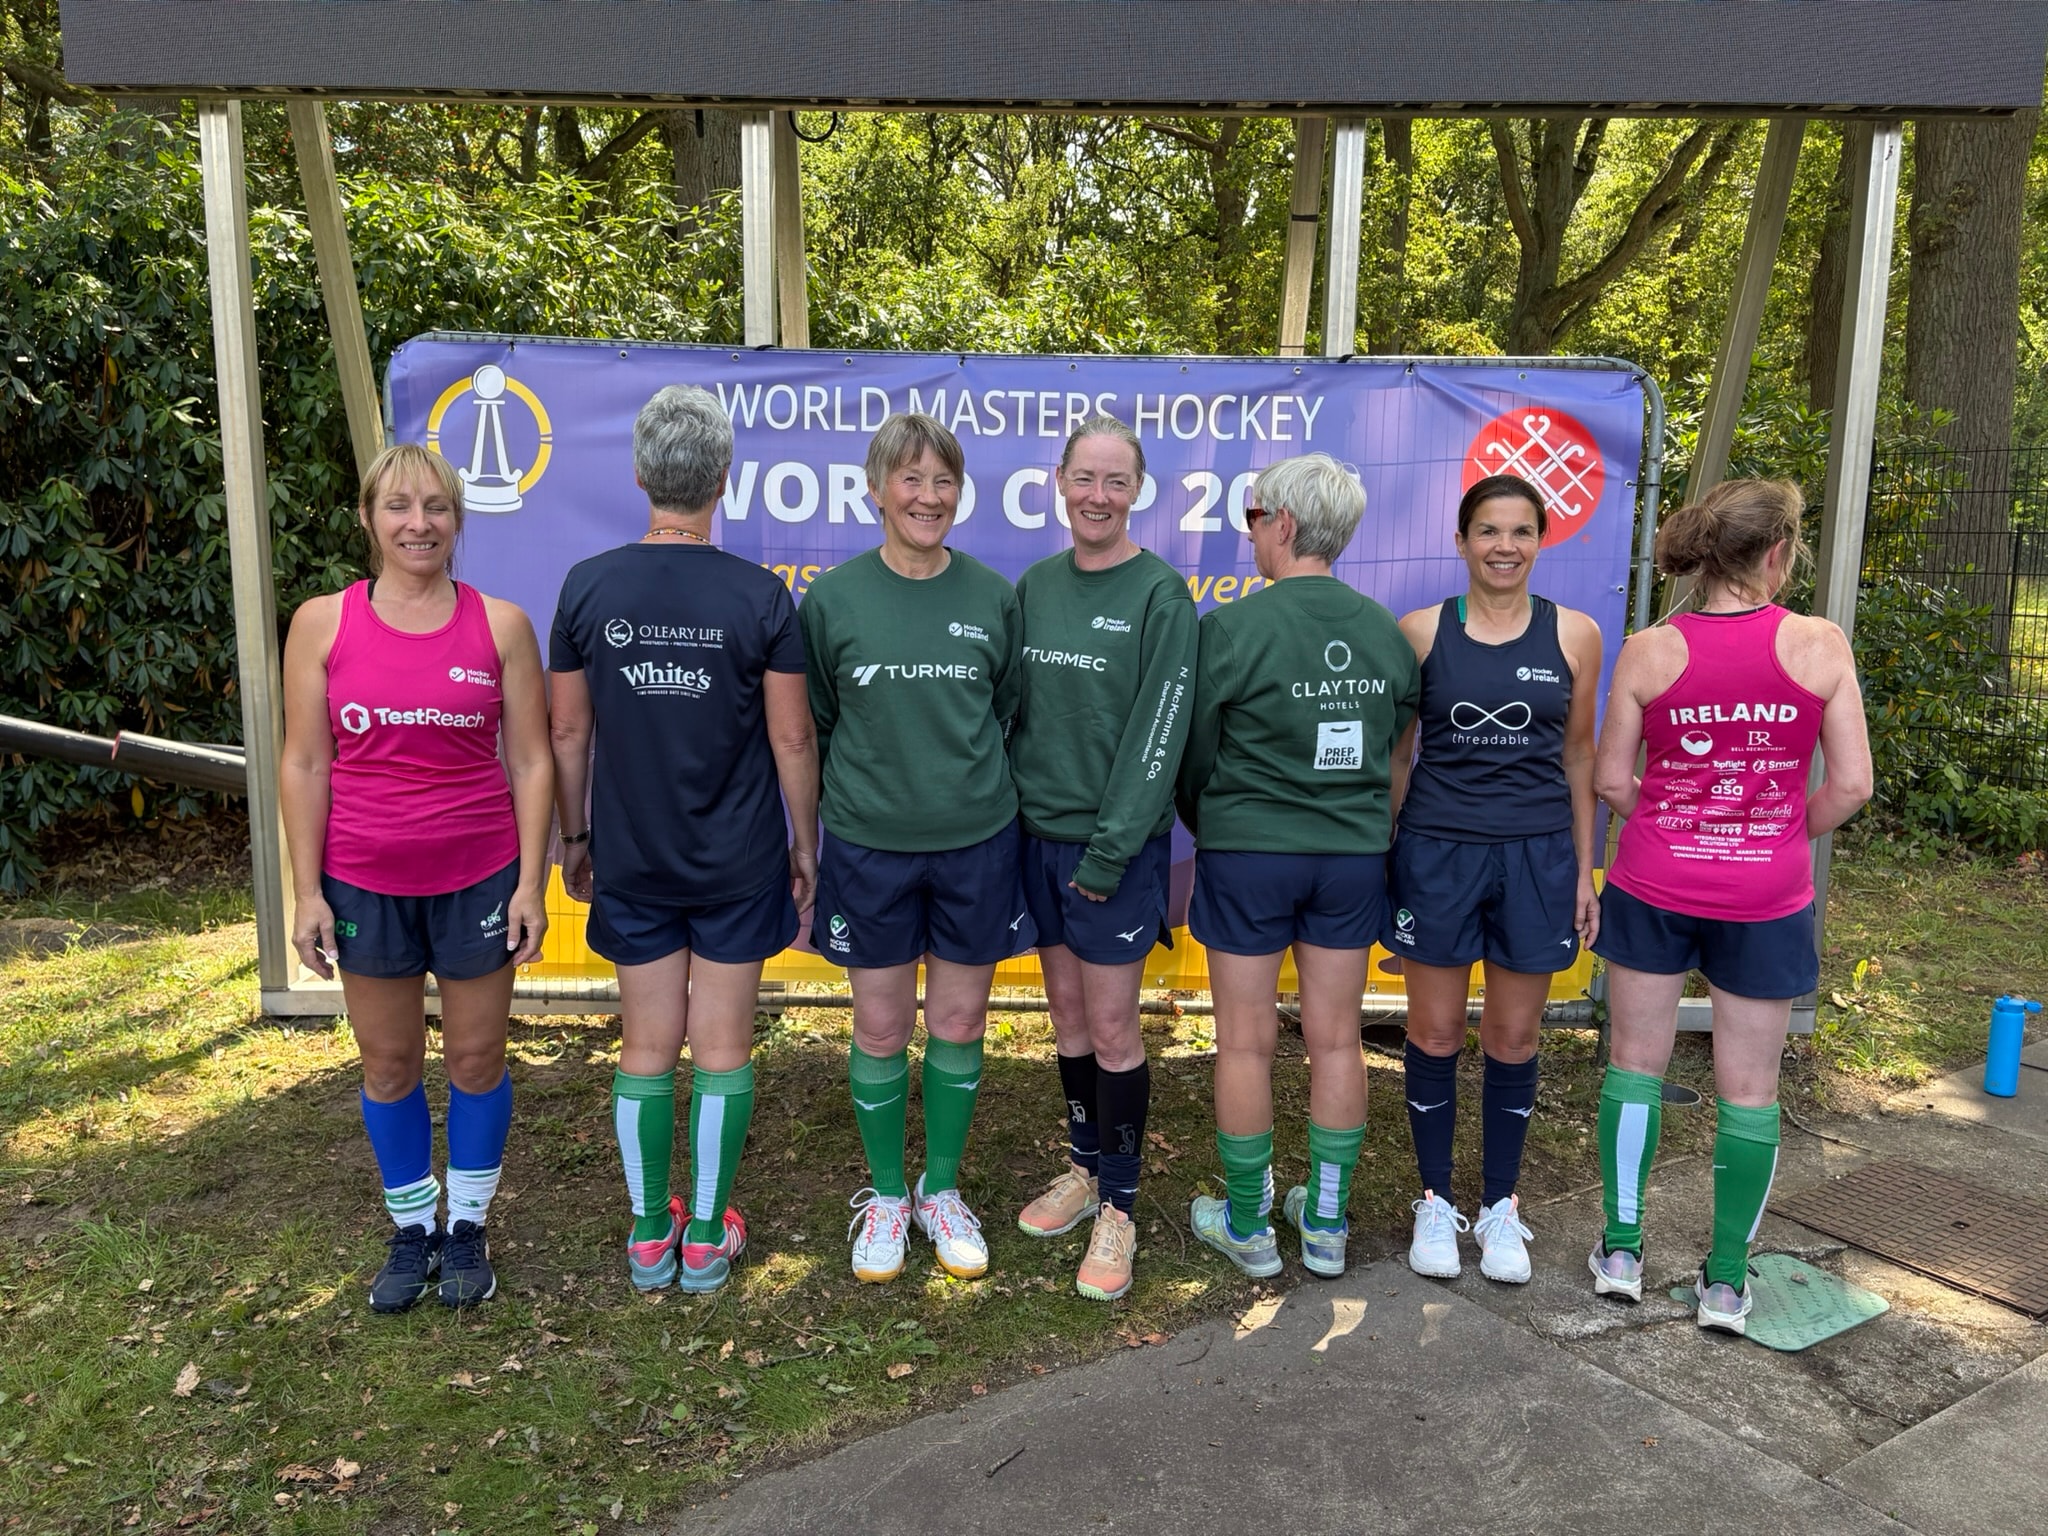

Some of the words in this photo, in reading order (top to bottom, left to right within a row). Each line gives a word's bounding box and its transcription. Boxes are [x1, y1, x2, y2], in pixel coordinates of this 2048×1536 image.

[716, 383, 891, 432] WORLD
[1136, 393, 1325, 442] HOCKEY
[639, 625, 697, 640] O'LEARY
[699, 628, 724, 642] LIFE
[963, 624, 983, 633] Hockey
[1103, 623, 1132, 633] Ireland
[963, 630, 989, 642] Ireland
[1030, 648, 1108, 672] TURMEC
[466, 669, 490, 679] Hockey
[619, 661, 712, 690] White's
[884, 664, 979, 680] TURMEC
[1178, 666, 1189, 680] N.
[1532, 668, 1553, 676] Hockey
[1532, 673, 1560, 683] Ireland
[467, 675, 496, 687] Ireland
[1291, 679, 1386, 698] CLAYTON
[1155, 680, 1171, 718] Chartered
[1320, 701, 1360, 711] HOTELS
[373, 707, 486, 728] TestReach
[1159, 684, 1185, 745] McKenna
[1669, 703, 1798, 725] IRELAND
[1141, 718, 1161, 763] Accountants
[1452, 733, 1530, 745] threadable
[1747, 730, 1773, 746] BR
[1154, 747, 1166, 758] &
[1325, 747, 1355, 757] PREP
[1318, 757, 1359, 767] HOUSE
[1768, 759, 1799, 769] Smart
[1711, 784, 1743, 796] asa
[1750, 804, 1793, 820] Glenfield
